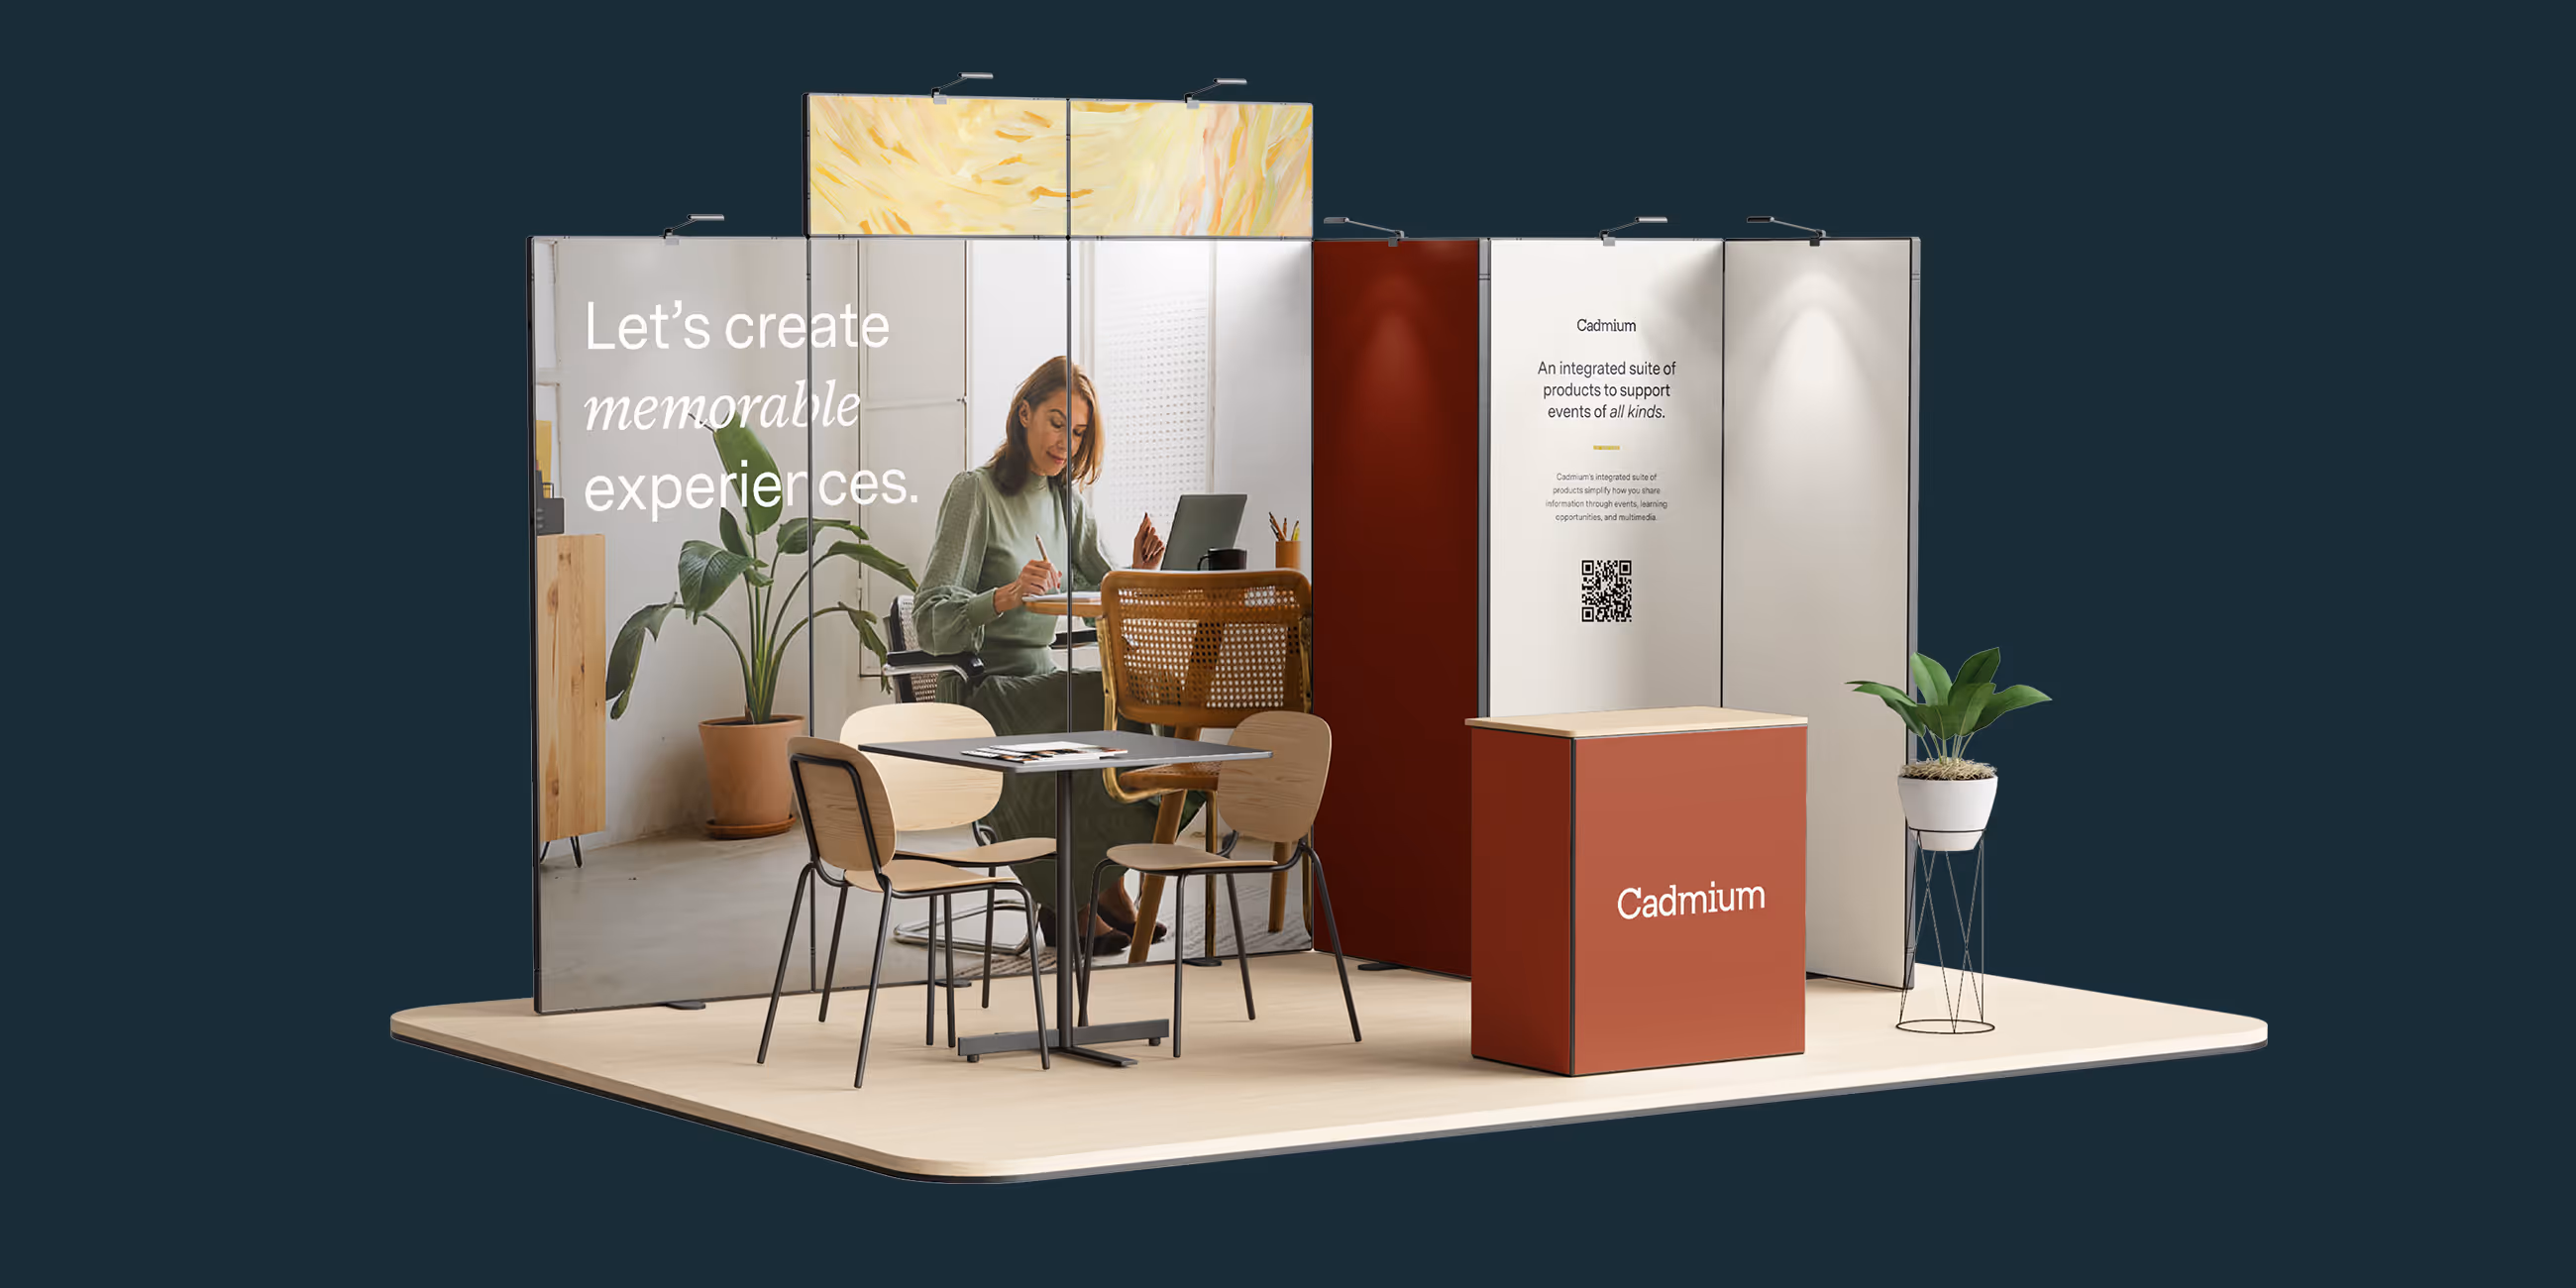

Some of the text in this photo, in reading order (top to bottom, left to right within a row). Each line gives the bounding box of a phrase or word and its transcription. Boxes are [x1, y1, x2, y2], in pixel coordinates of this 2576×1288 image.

[725, 304, 890, 349] create
[1576, 318, 1637, 333] Cadmium
[1538, 361, 1676, 378] An integrated suite of
[1544, 382, 1671, 400] products to support
[584, 378, 861, 431] memorable
[1548, 404, 1665, 418] events of all kinds.
[1595, 474, 1631, 483] integrated
[1553, 486, 1583, 495] products
[1584, 486, 1611, 495] simplify
[1546, 499, 1667, 509] information through events, learning
[1555, 513, 1603, 522] opportunities,
[1617, 880, 1766, 920] Cadmium
